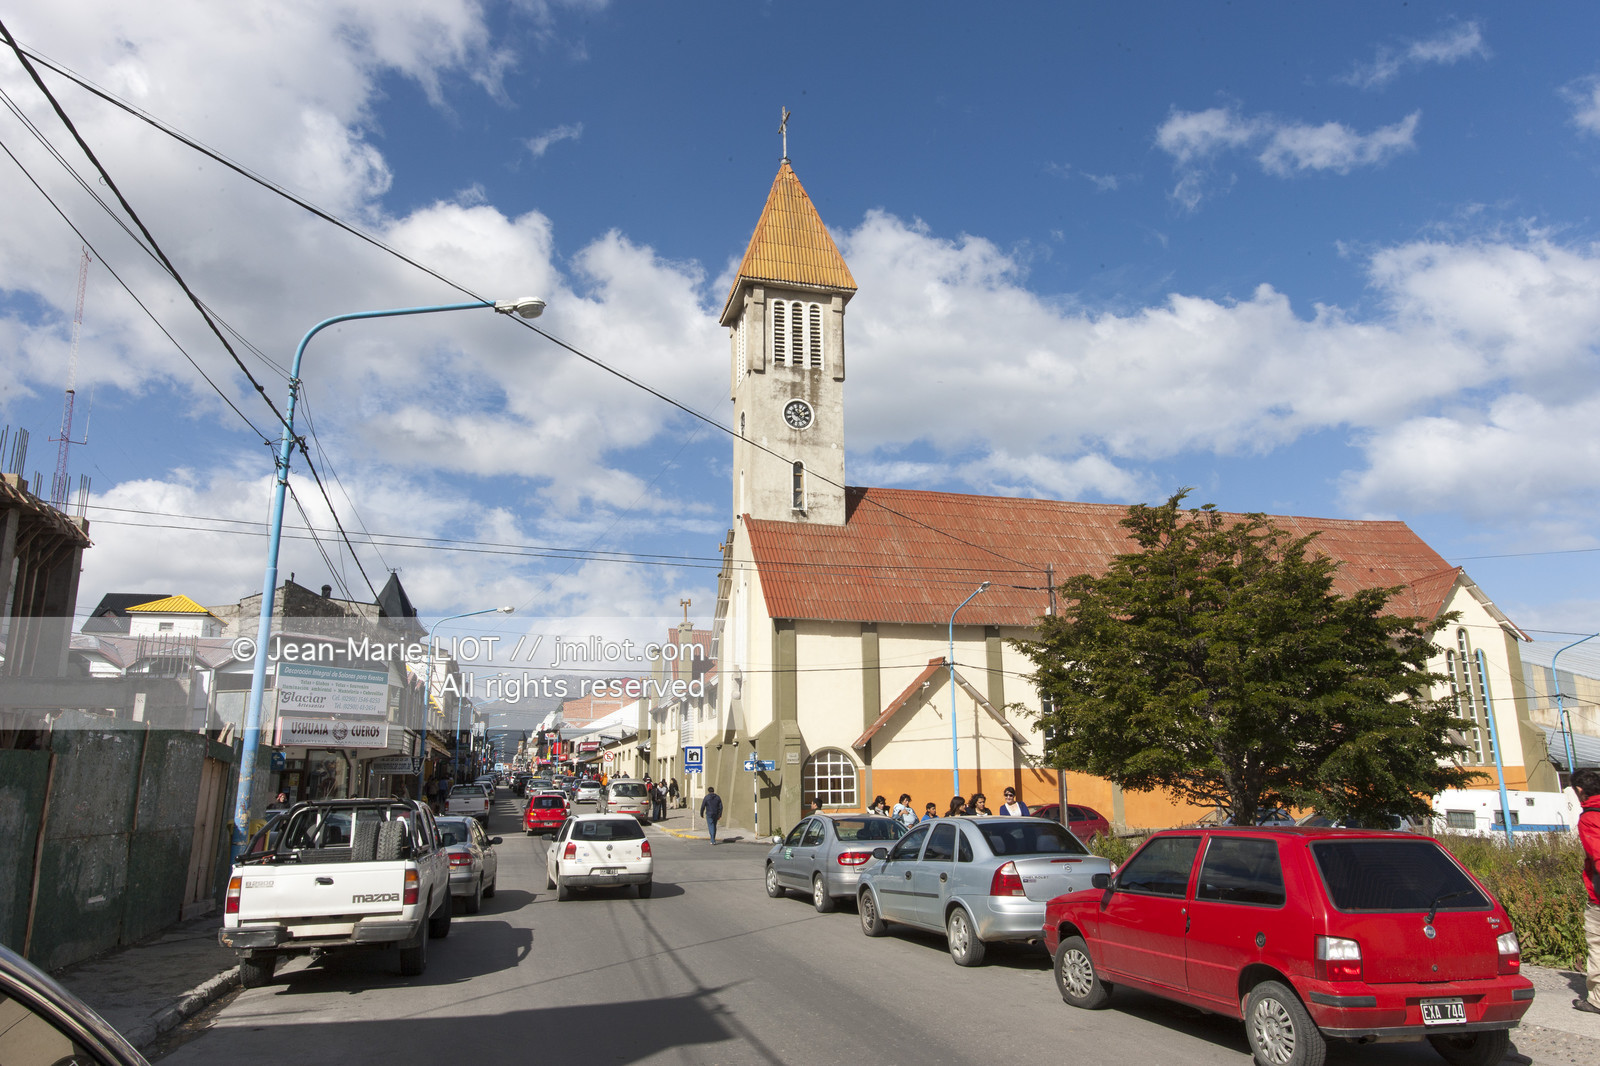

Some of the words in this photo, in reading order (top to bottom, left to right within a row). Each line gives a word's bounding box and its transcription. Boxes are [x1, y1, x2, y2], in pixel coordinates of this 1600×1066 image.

[312, 669, 331, 678] Integral
[281, 691, 327, 703] Glaciar
[291, 722, 329, 736] USHUAIA
[351, 725, 380, 737] CUEROS
[1423, 1005, 1442, 1020] EXA
[1445, 1004, 1464, 1018] 744
